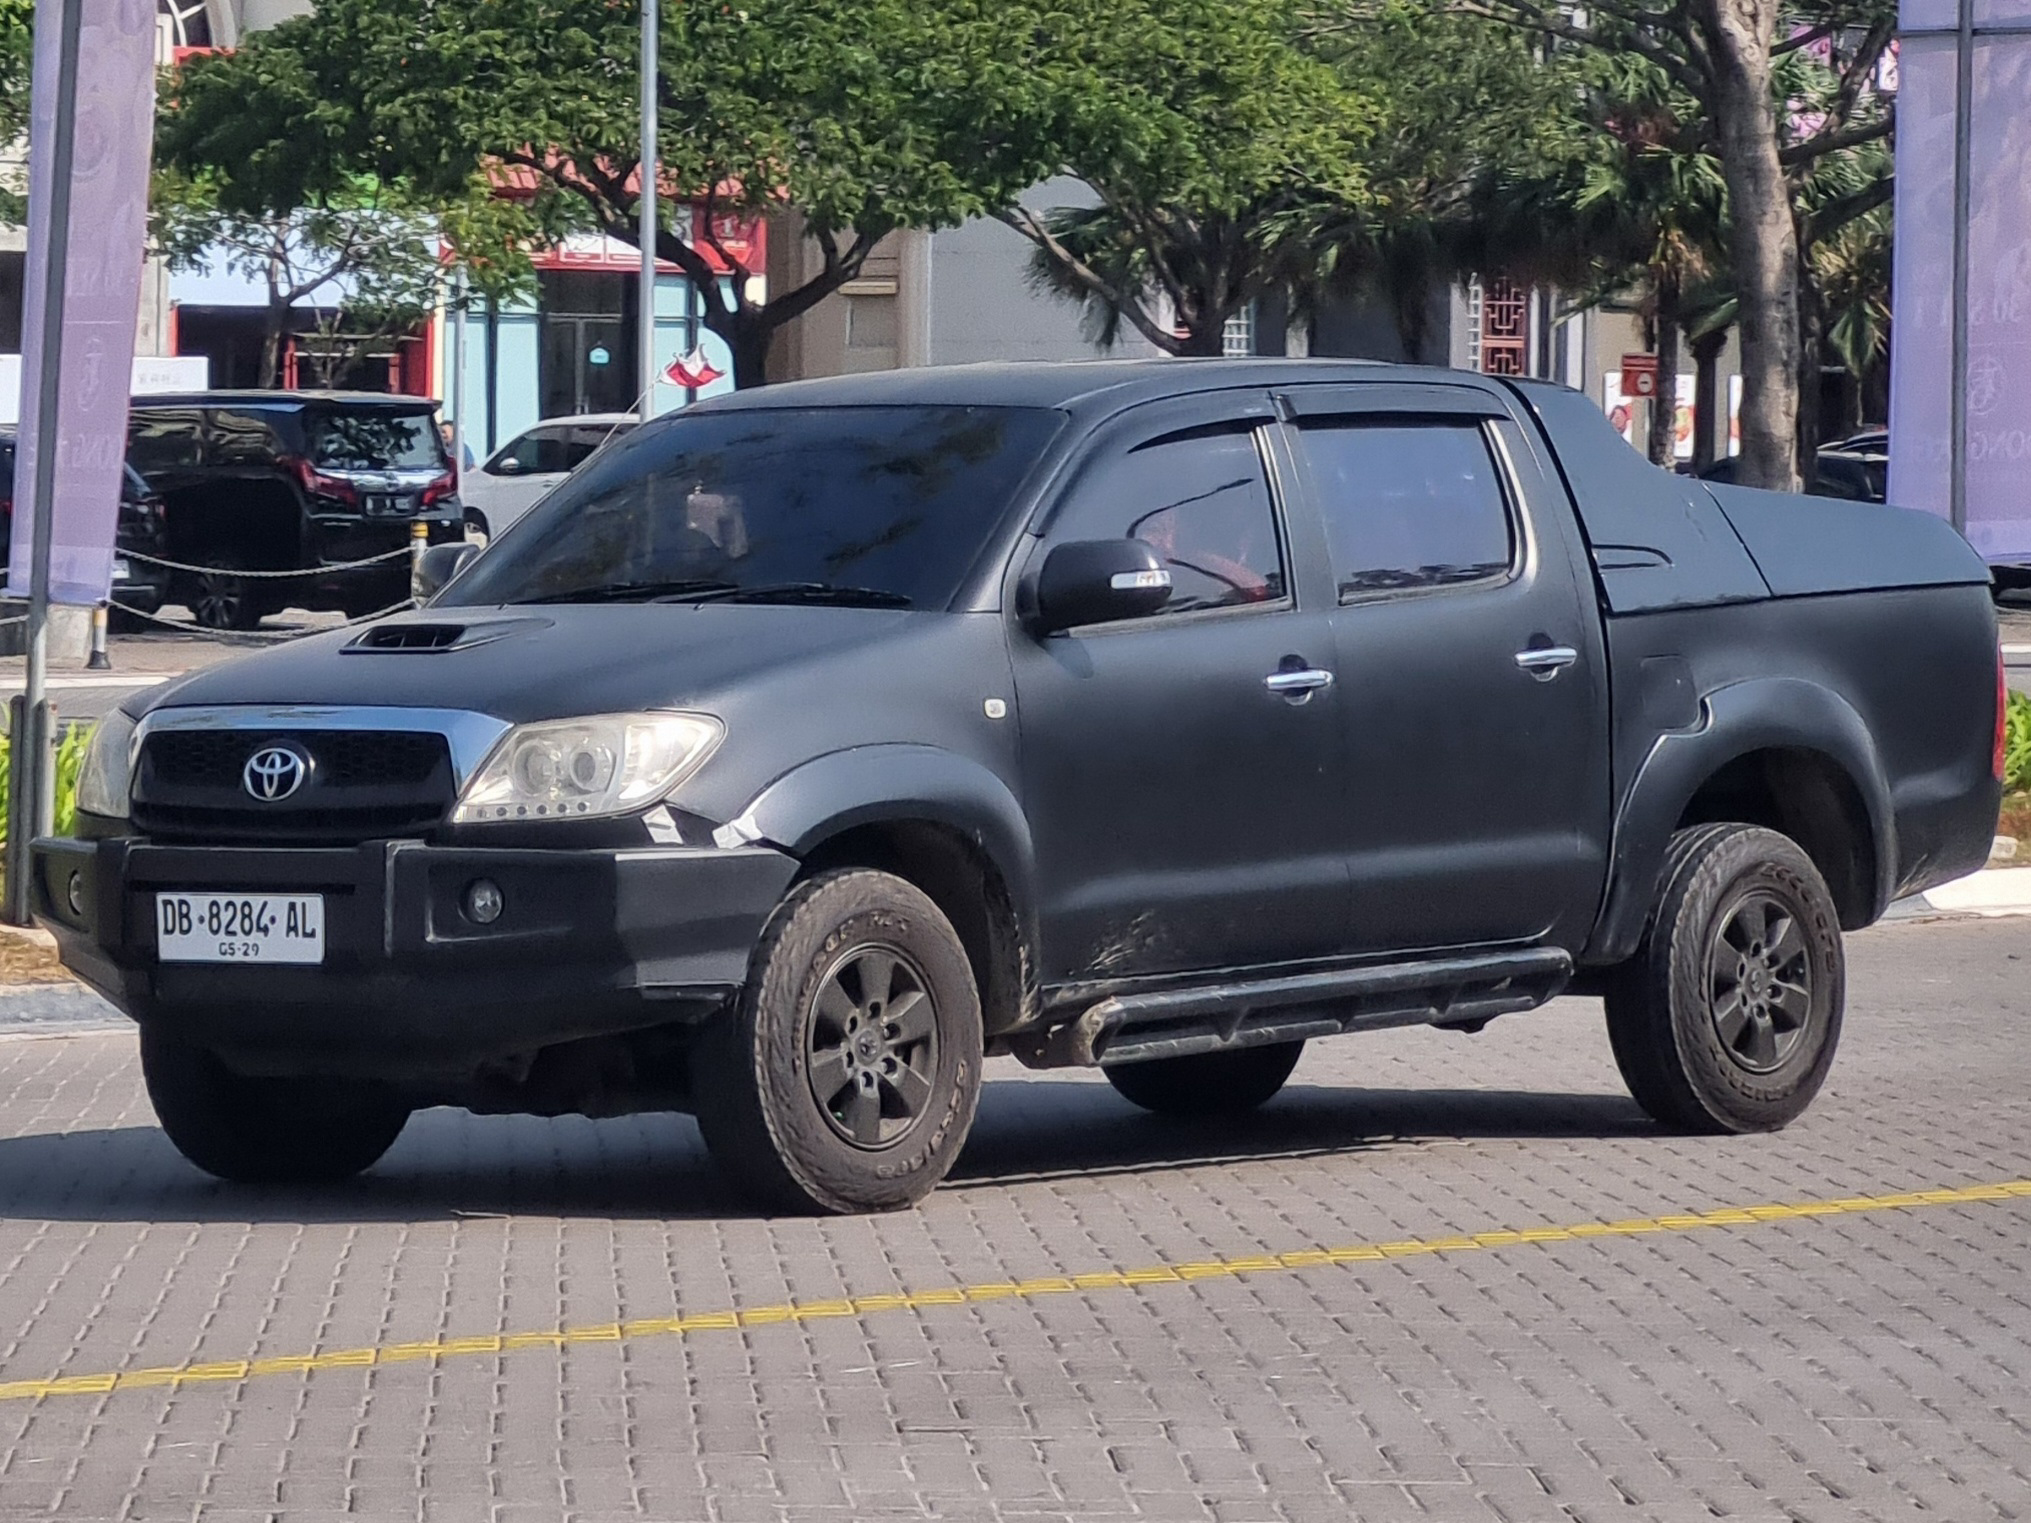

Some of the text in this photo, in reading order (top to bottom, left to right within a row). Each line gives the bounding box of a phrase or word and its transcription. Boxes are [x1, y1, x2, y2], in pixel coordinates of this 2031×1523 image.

[161, 898, 317, 939] DB 8284 AL
